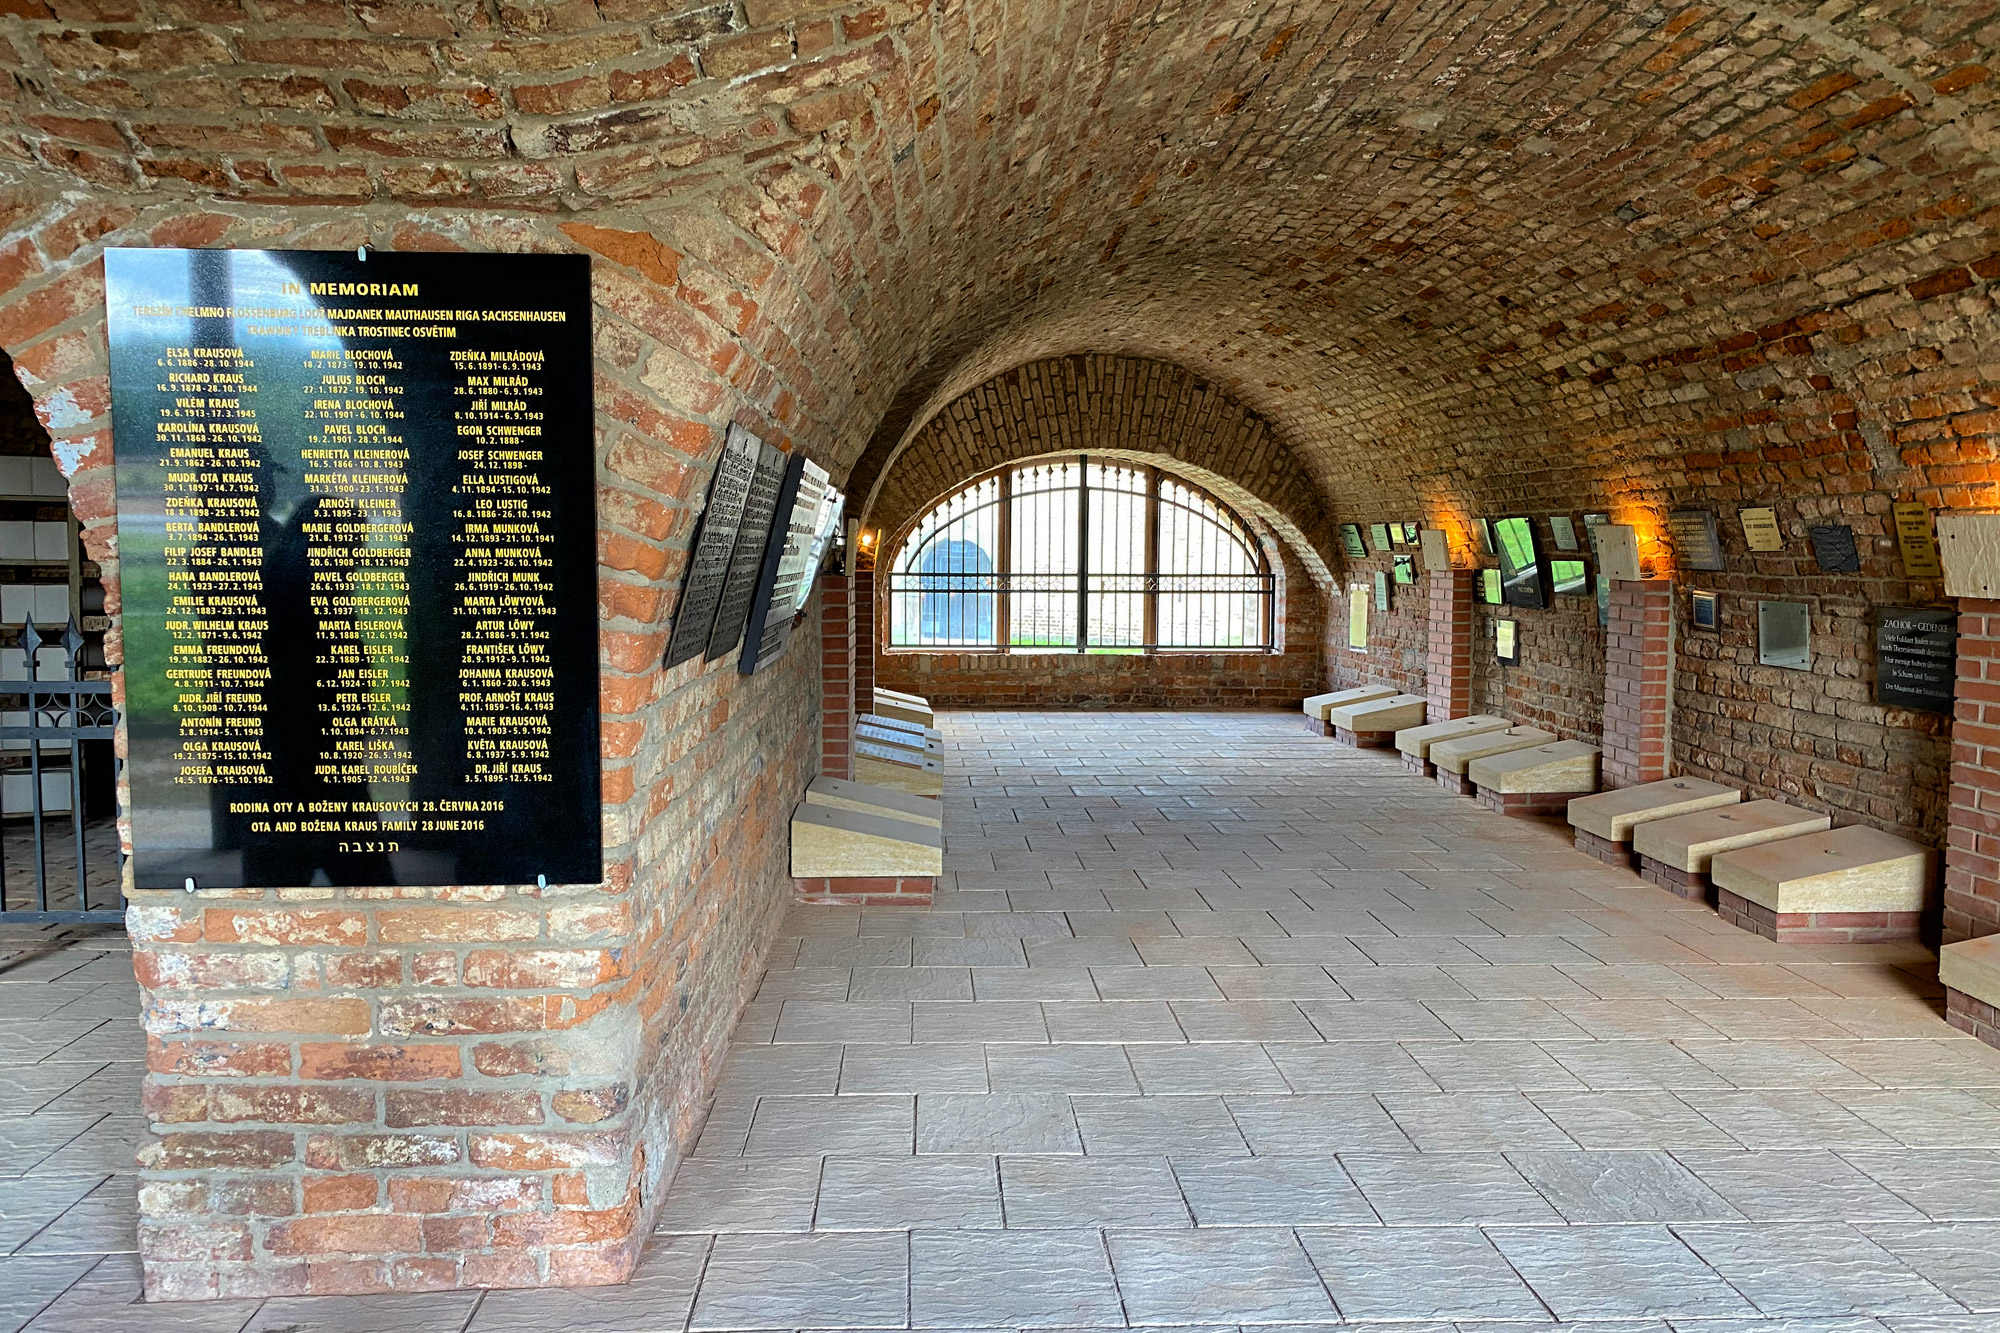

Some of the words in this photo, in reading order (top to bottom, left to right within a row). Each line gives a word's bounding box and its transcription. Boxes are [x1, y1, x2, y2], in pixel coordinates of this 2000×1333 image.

[281, 281, 300, 294] IN
[310, 282, 419, 296] MEMORIAM
[174, 306, 224, 318] CHELMNO
[327, 308, 382, 320] MAJDANEK
[384, 309, 453, 321] MAUTHAUSEN
[455, 310, 480, 321] RIGA
[482, 310, 566, 322] SACHSENHAUSEN
[301, 325, 355, 336] TREBLINKA
[358, 326, 410, 337] TROSTINEC
[412, 324, 456, 337] OSVĚTIM
[166, 348, 190, 358] ELSA
[193, 345, 243, 358] KRAUSOVÁ
[311, 350, 340, 360] MARIE
[344, 347, 393, 360] BLOCHOVÁ
[449, 348, 486, 361] ZDEŇKA
[490, 348, 544, 362] MILRÁDOVÁ
[168, 374, 210, 383] RICHARD
[212, 374, 244, 384] KRAUS
[321, 375, 352, 385] JULIUS
[355, 376, 385, 385] BLOCH
[467, 377, 489, 386] MAX
[492, 373, 528, 386] MILRÁD
[175, 395, 204, 408] VILÉM
[208, 399, 239, 408] KRAUS
[313, 400, 341, 409] IRENA
[345, 396, 394, 410] BLOCHOVÁ
[470, 398, 487, 411] JIŘÍ
[491, 398, 527, 411] MILRÁD
[156, 420, 205, 433] KAROLÍNA
[208, 420, 259, 433] KRAUSOVÁ
[324, 425, 352, 434] PAVEL
[355, 425, 386, 434] BLOCH
[456, 426, 482, 435] EGON
[486, 426, 542, 436] SCHWENGER
[169, 448, 214, 458] EMANUEL
[218, 449, 249, 458] KRAUS
[301, 449, 349, 459] HENRIETTA
[353, 446, 410, 459] KLEINEROVÁ
[457, 450, 484, 460] JOSEF
[487, 451, 543, 460] SCHWENGER
[304, 471, 348, 484] MARKÉTA
[351, 471, 408, 484] KLEINEROVÁ
[462, 475, 484, 484] ELLA
[488, 472, 538, 485] LUSTIGOVÁ
[165, 494, 203, 508] ZDEŇKA
[206, 495, 257, 508] KRAUSOVÁ
[318, 495, 355, 508] ARNOŠT
[358, 499, 396, 508] KLEINER
[475, 500, 492, 509] LEO
[496, 500, 527, 509] LUSTIG
[166, 523, 194, 532] BERTA
[198, 519, 260, 532] BANDLEROVÁ
[301, 523, 331, 533] MARIE
[335, 520, 414, 533] GOLDBERGEROVÁ
[464, 524, 489, 533] IRMA
[492, 520, 539, 533] MUNKOVÁ
[164, 548, 186, 557] FILIP
[190, 548, 217, 557] JOSEF
[220, 548, 263, 557] BANDLER
[306, 544, 348, 557] JINDŘICH
[351, 548, 411, 557] GOLDBERGER
[464, 548, 491, 557] ANNA
[494, 545, 541, 557] MUNKOVÁ
[168, 572, 195, 581] HANA
[198, 568, 261, 581] BANDLEROVÁ
[314, 572, 342, 581] PAVEL
[345, 572, 405, 581] GOLDBERGER
[467, 569, 508, 582] JINDŘICH
[512, 573, 540, 582] MUNK
[173, 596, 204, 606] EMILIE
[207, 593, 258, 606] KRAUSOVÁ
[310, 597, 328, 606] EVA
[331, 593, 410, 606] GOLDBERGEROVÁ
[463, 597, 495, 606] MARTA
[499, 593, 544, 606] LÖWYOVÁ
[318, 621, 350, 630] MARTA
[354, 617, 403, 630] EISLEROVÁ
[475, 621, 504, 630] ARTUR
[508, 617, 534, 630] LÖWY
[1883, 619, 1912, 630] ZACHOR
[1918, 622, 1949, 632] GEDENKE
[173, 645, 203, 654] EMMA
[206, 641, 261, 654] FREUNDOVÁ
[330, 645, 359, 654] KAREL
[363, 645, 393, 654] EISLER
[466, 641, 514, 654] FRANTIŠEK
[518, 641, 544, 654] LÖWY
[165, 670, 213, 679] GERTRUDE
[216, 666, 272, 679] FREUNDOVÁ
[337, 669, 355, 678] JAN
[358, 669, 388, 678] EISLER
[458, 669, 501, 678] JOHANNA
[505, 665, 554, 678] KRAUSOVÁ
[335, 693, 357, 702] PETR
[361, 693, 391, 702] EISLER
[484, 689, 520, 702] ARNOŠT
[524, 692, 554, 701] KRAUS
[180, 714, 222, 727] ANTONÍN
[225, 718, 261, 727] FREUND
[332, 717, 357, 726] OLGA
[360, 713, 396, 726] KRÁTKÁ
[466, 716, 495, 725] MARIE
[499, 713, 548, 725] KRAUSOVÁ
[182, 742, 208, 751] OLGA
[211, 738, 261, 751] KRAUSOVÁ
[335, 741, 364, 750] KAREL
[368, 737, 394, 750] LIŠKA
[467, 737, 495, 749] KVĚTA
[499, 736, 548, 749] KRAUSOVÁ
[180, 766, 213, 775] JOSEFA
[216, 762, 266, 775] KRAUSOVÁ
[491, 760, 508, 773] JIŘÍ
[511, 764, 541, 772] KRAUS
[229, 802, 269, 812] RODINA
[273, 802, 293, 812] OTY
[296, 802, 305, 812] A
[308, 799, 348, 812] BOŽENY
[351, 798, 418, 811] KRAUSOVÝCH
[480, 800, 504, 810] 2016
[251, 822, 271, 832] OTA
[274, 821, 296, 832] AND
[300, 818, 341, 831] BOŽENA
[344, 820, 377, 831] KRAUS
[381, 820, 418, 830] FAMILY
[460, 819, 484, 830] 2016
